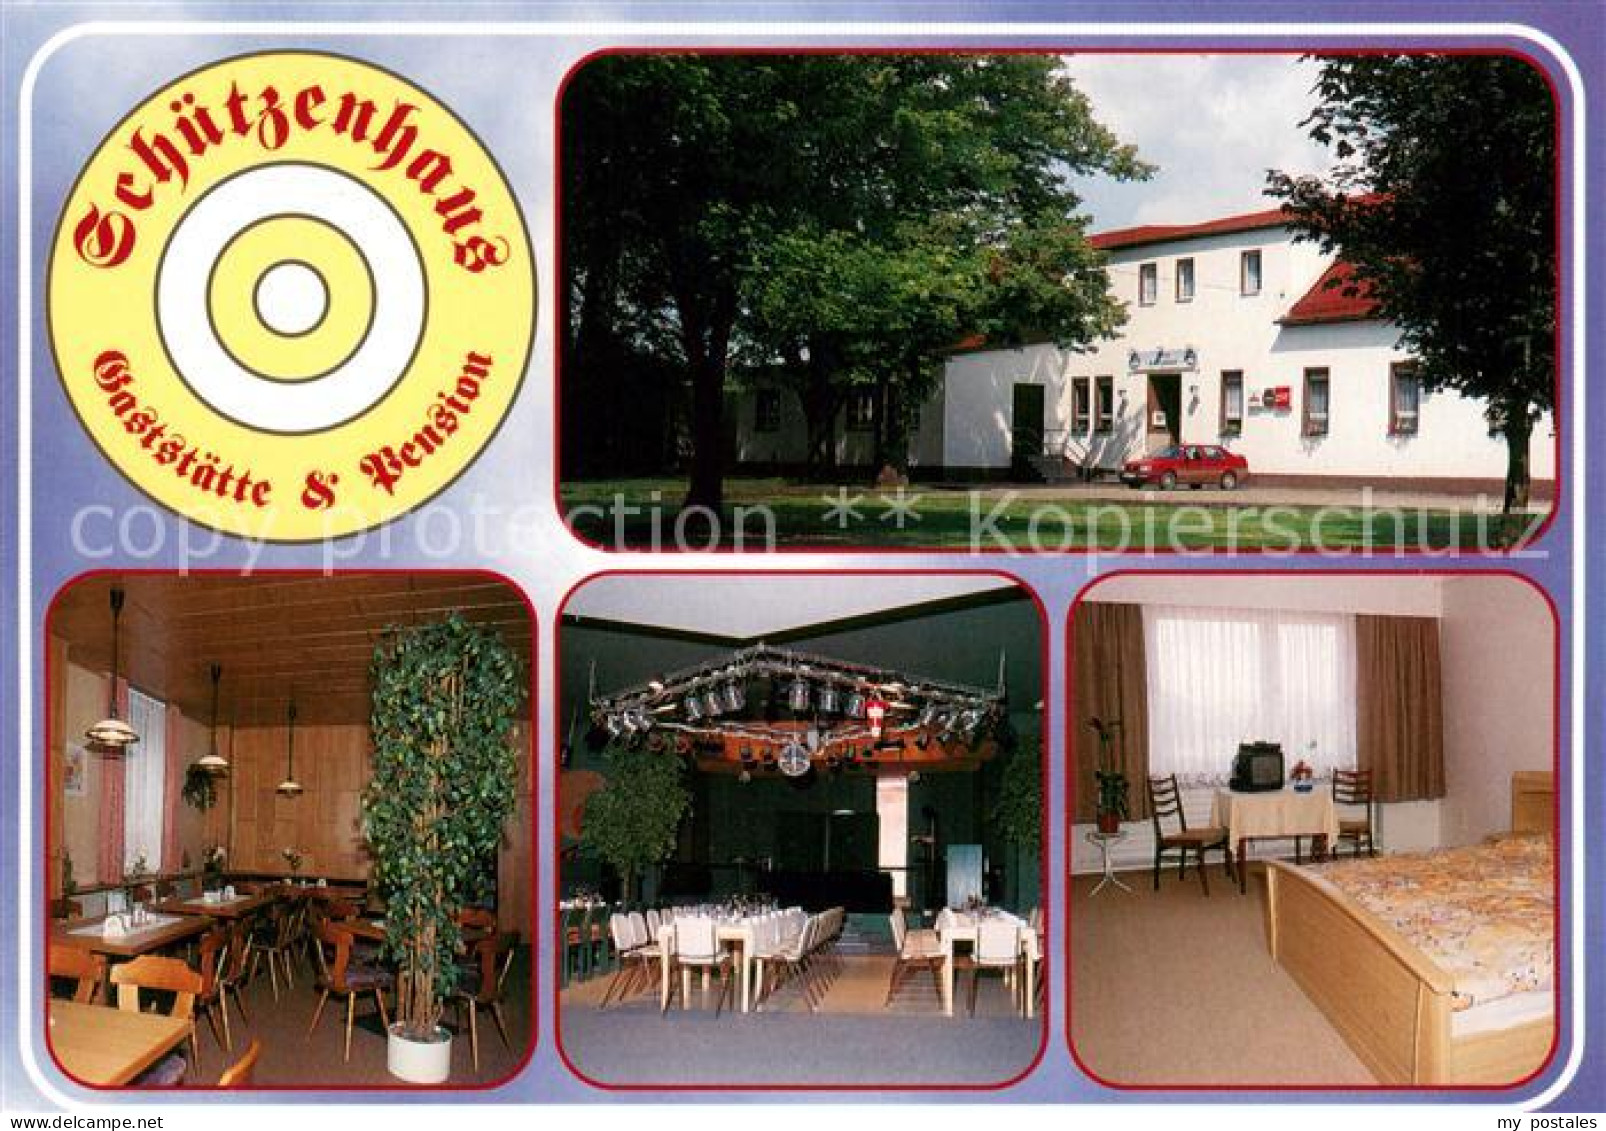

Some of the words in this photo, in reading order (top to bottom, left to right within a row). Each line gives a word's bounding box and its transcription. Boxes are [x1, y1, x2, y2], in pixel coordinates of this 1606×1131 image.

[73, 80, 510, 274] Schützenhaus
[94, 350, 272, 508] Gaststätte
[301, 470, 340, 510] &
[360, 351, 493, 496] Pension
